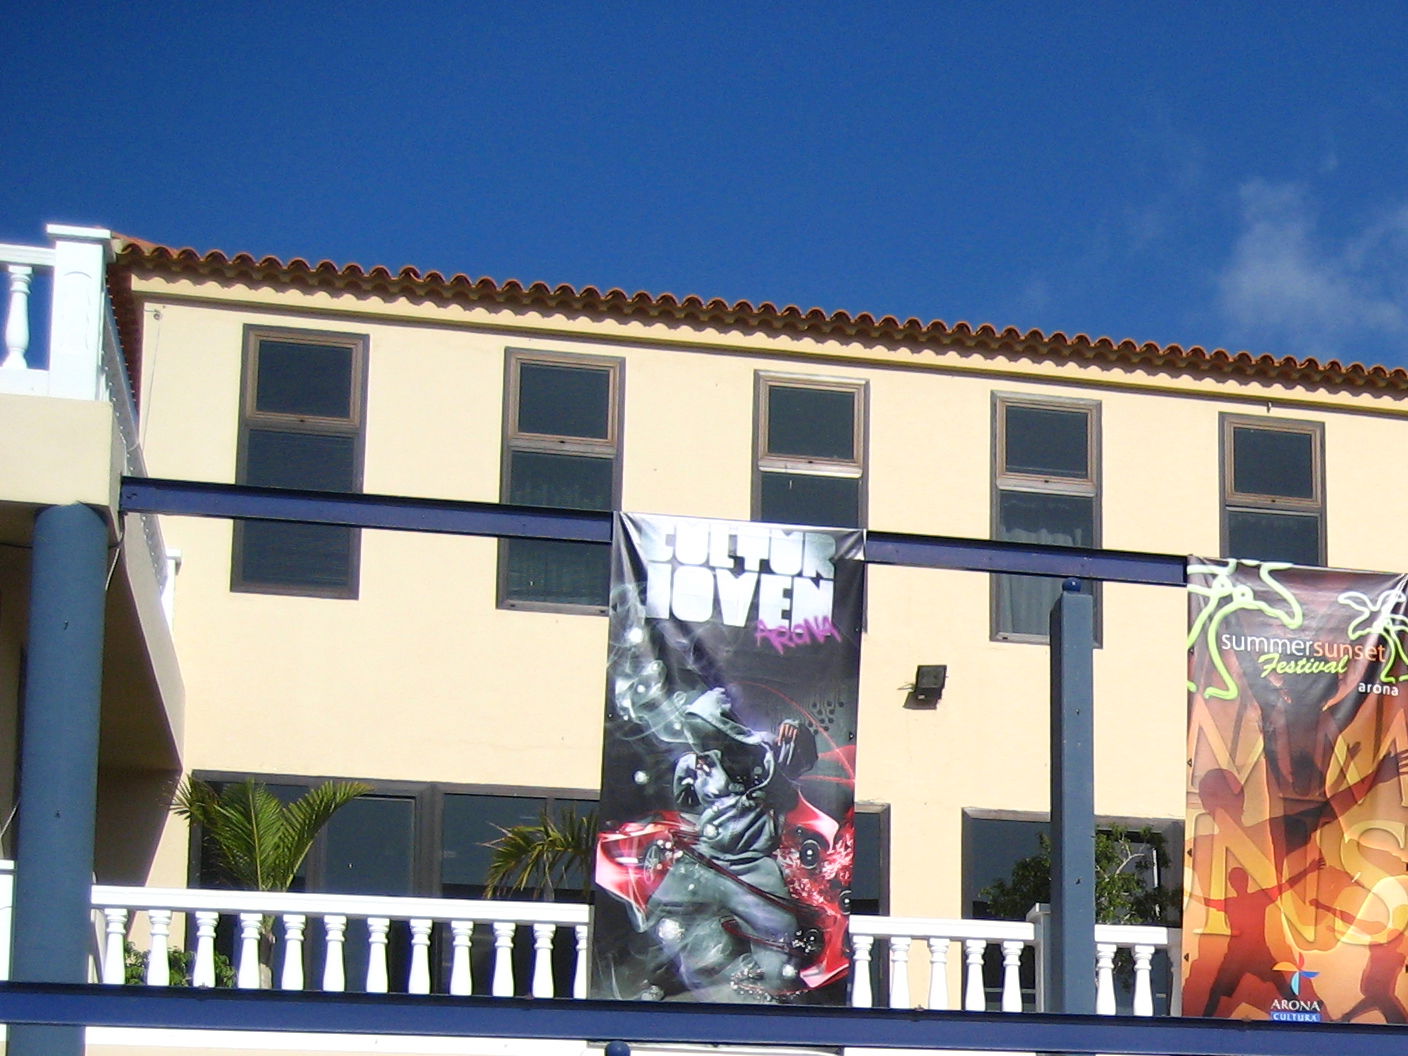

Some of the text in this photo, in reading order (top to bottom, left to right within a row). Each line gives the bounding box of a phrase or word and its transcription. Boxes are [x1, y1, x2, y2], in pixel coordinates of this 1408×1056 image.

[640, 522, 836, 579] CULTUR
[755, 615, 842, 655] ARONA
[1258, 653, 1350, 678] Festival
[1358, 681, 1399, 697] arona
[1270, 999, 1321, 1012] ARONA
[1273, 1013, 1317, 1022] CULTURA
